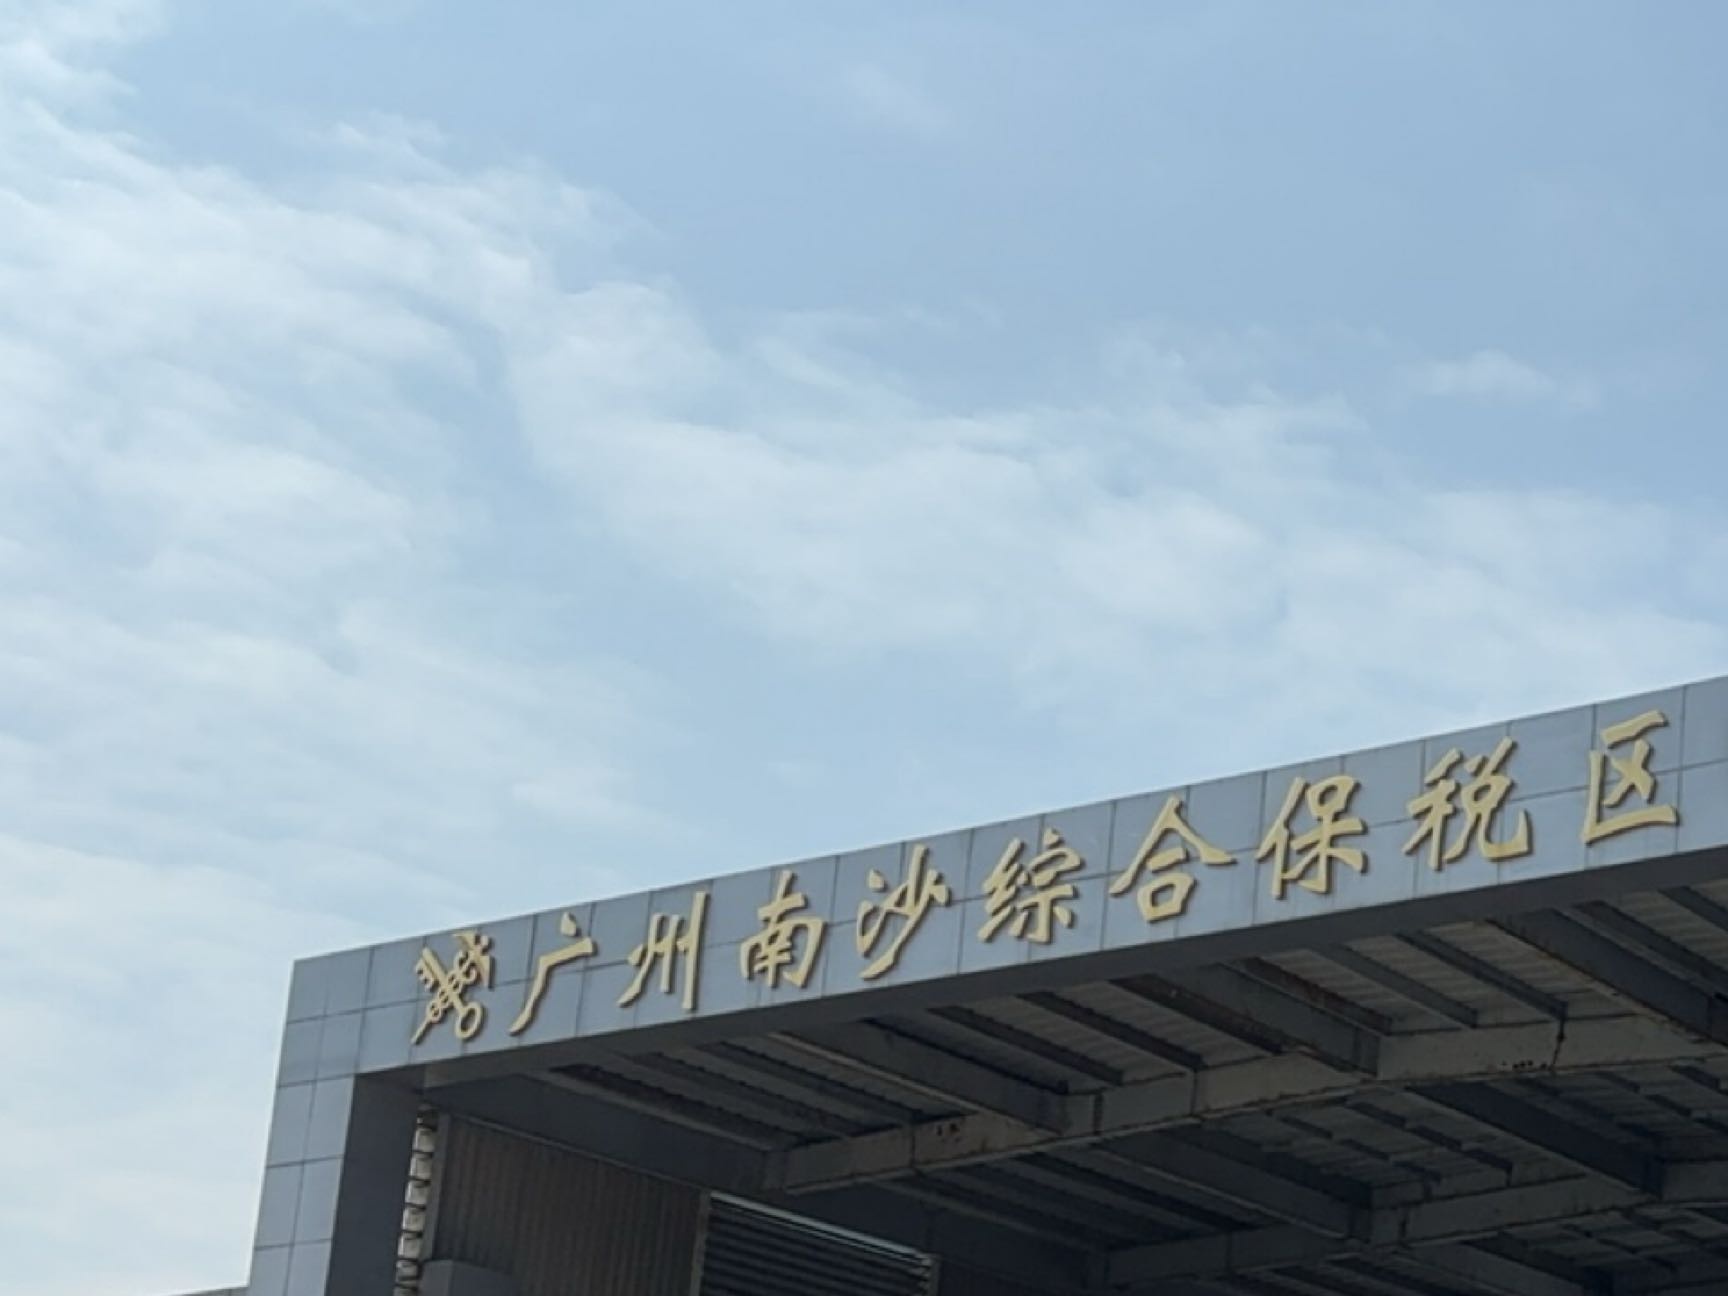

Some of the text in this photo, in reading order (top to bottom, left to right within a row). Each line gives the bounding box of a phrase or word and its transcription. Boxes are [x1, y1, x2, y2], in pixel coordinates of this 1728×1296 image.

[508, 709, 1680, 1036] 广州南沙综合保税区
